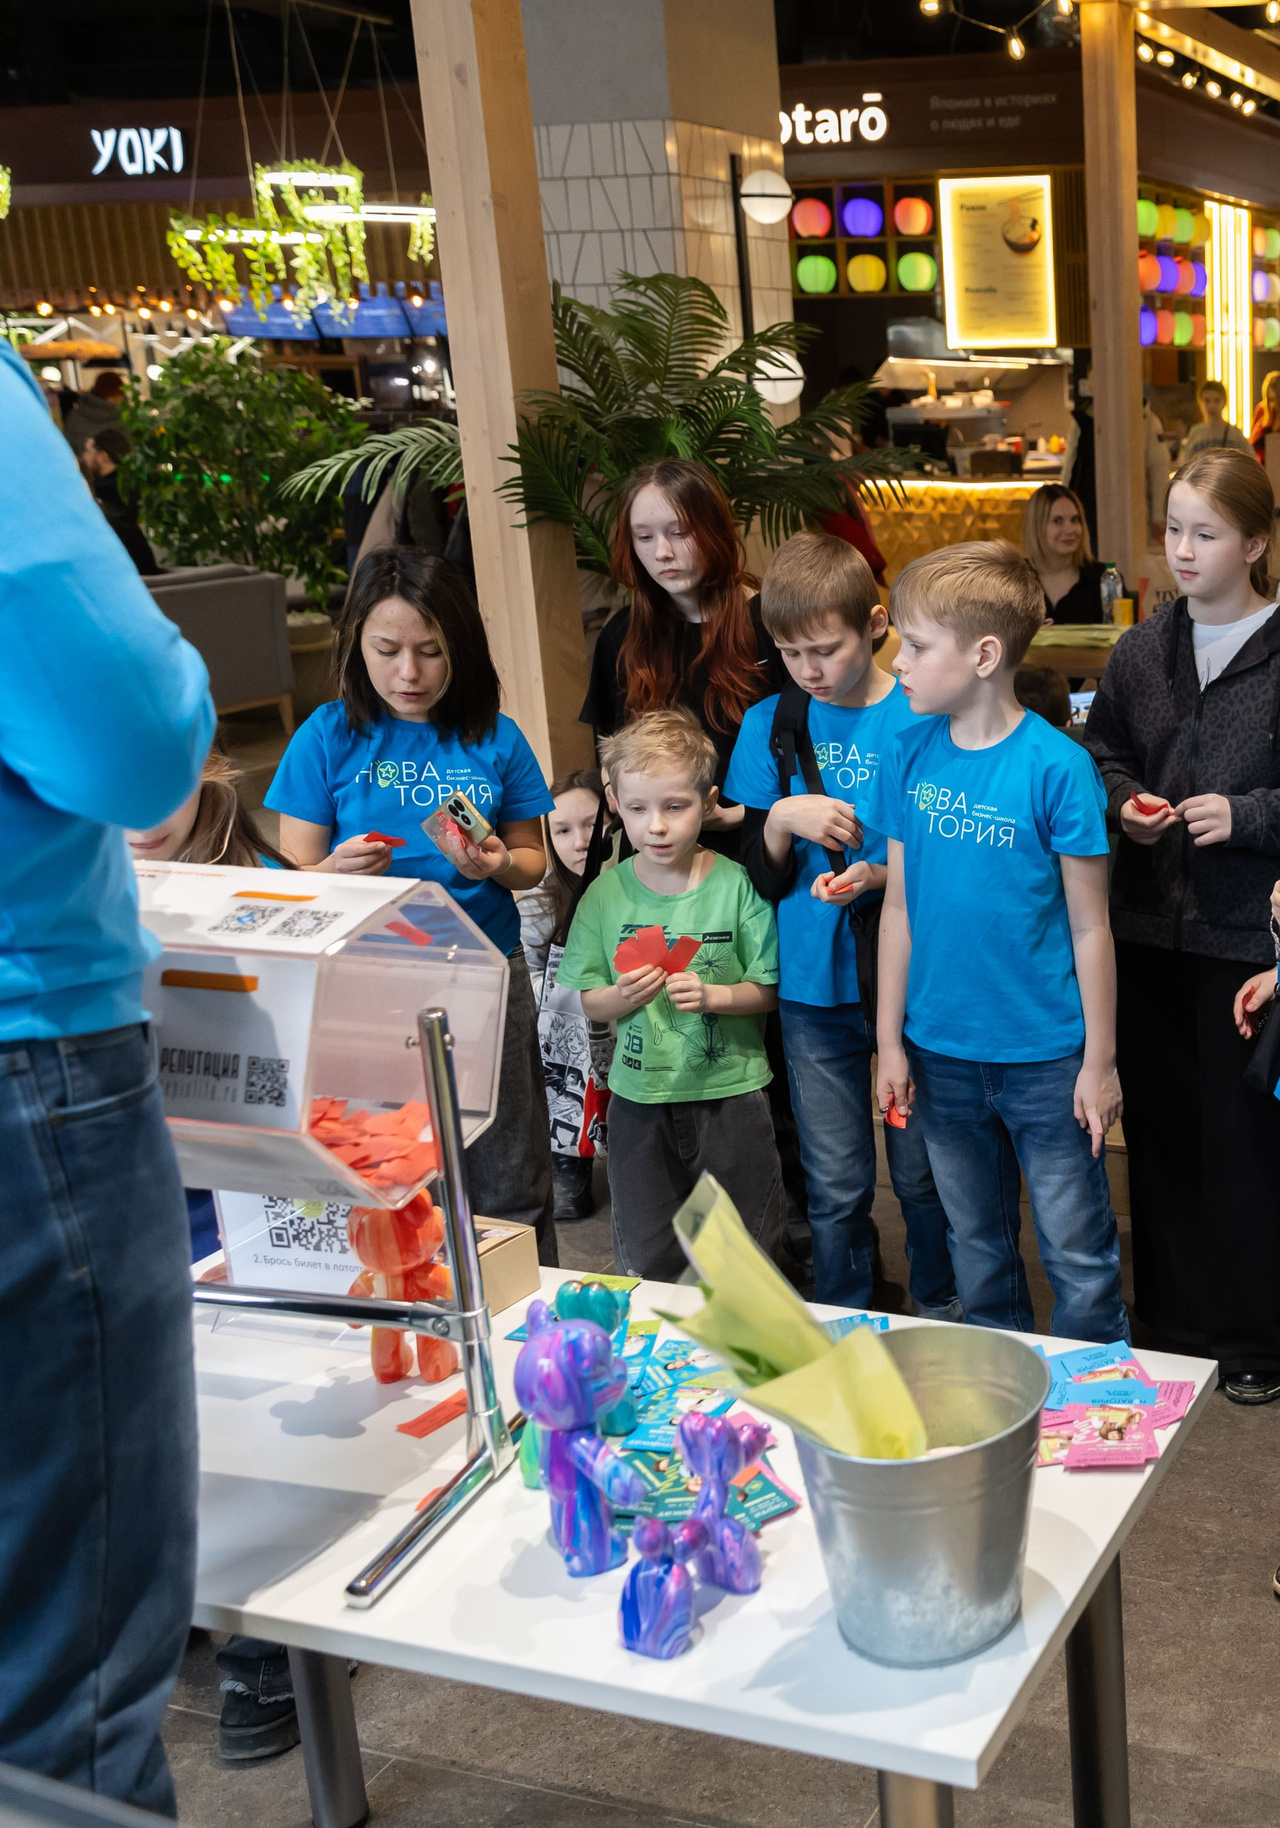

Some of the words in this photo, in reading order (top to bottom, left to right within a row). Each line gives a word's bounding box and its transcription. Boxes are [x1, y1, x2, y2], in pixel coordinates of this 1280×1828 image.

[927, 811, 1015, 848] ТОРИЯ
[264, 1255, 292, 1266] Брось
[294, 1258, 322, 1270] билет
